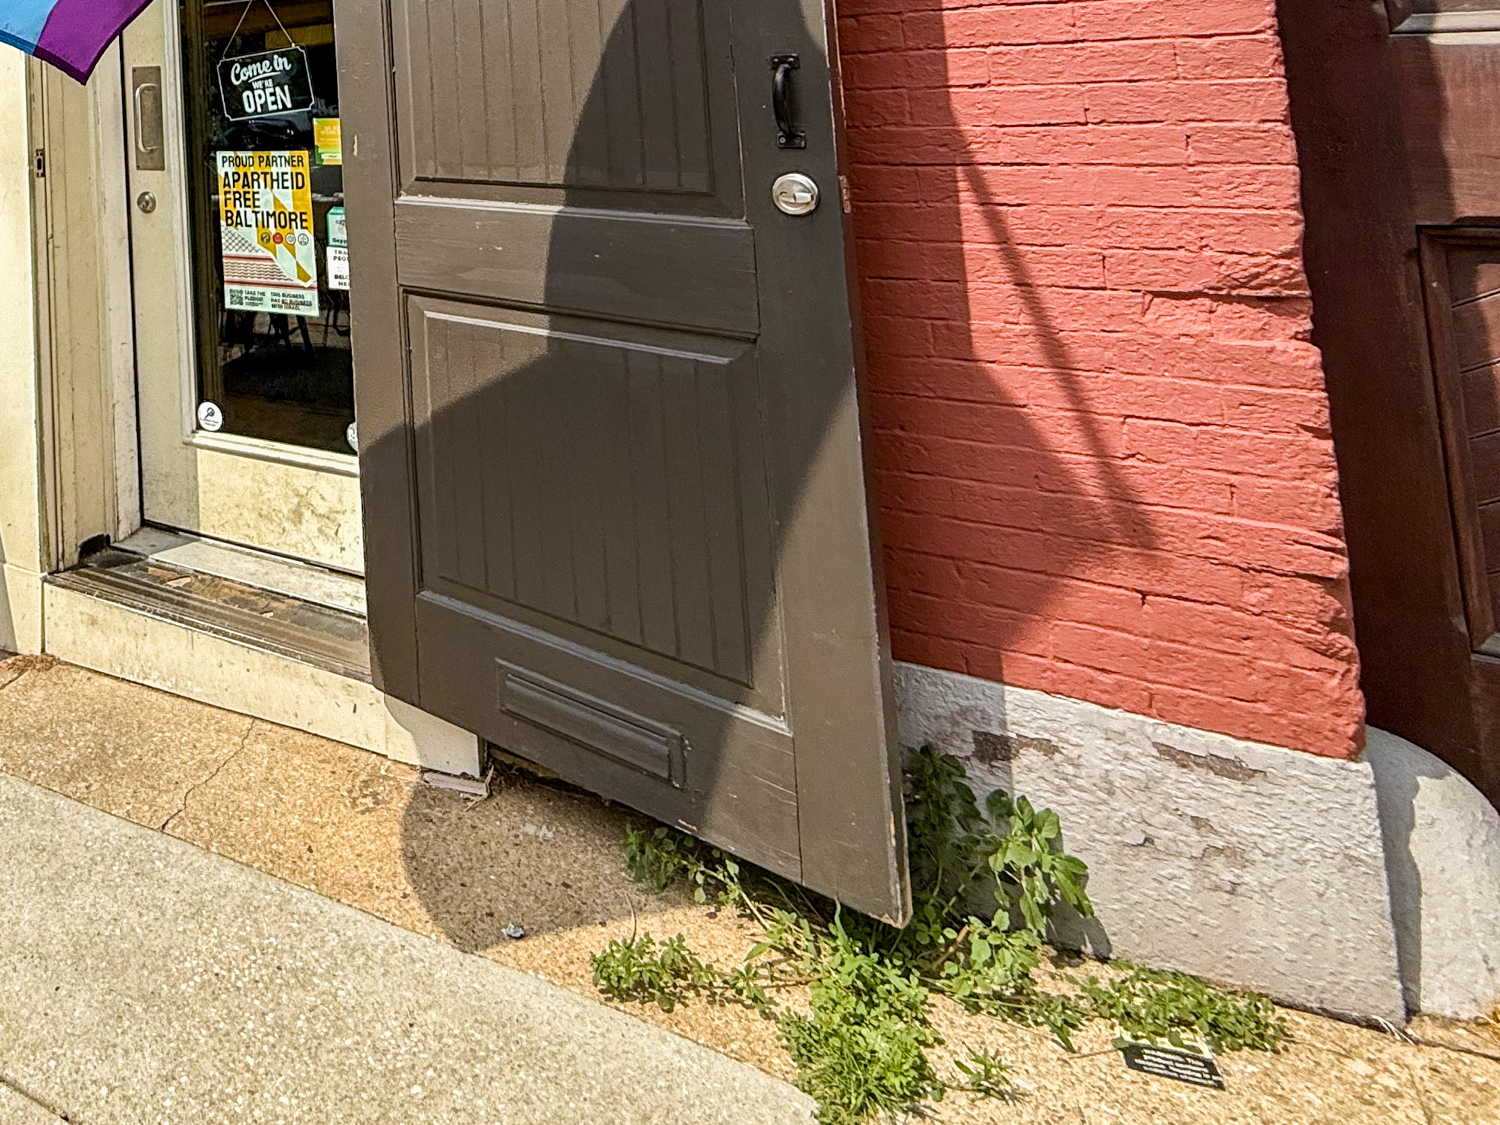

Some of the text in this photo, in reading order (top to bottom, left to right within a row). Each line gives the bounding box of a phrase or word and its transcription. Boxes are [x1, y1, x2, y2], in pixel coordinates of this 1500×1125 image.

[230, 54, 292, 86] Come in
[252, 78, 274, 89] WE'RE
[242, 85, 292, 113] OPEN
[221, 155, 304, 168] PROUD PARTNER
[223, 171, 305, 190] APARTHEID
[223, 190, 261, 208] FREE
[225, 210, 309, 230] BALTIMORE
